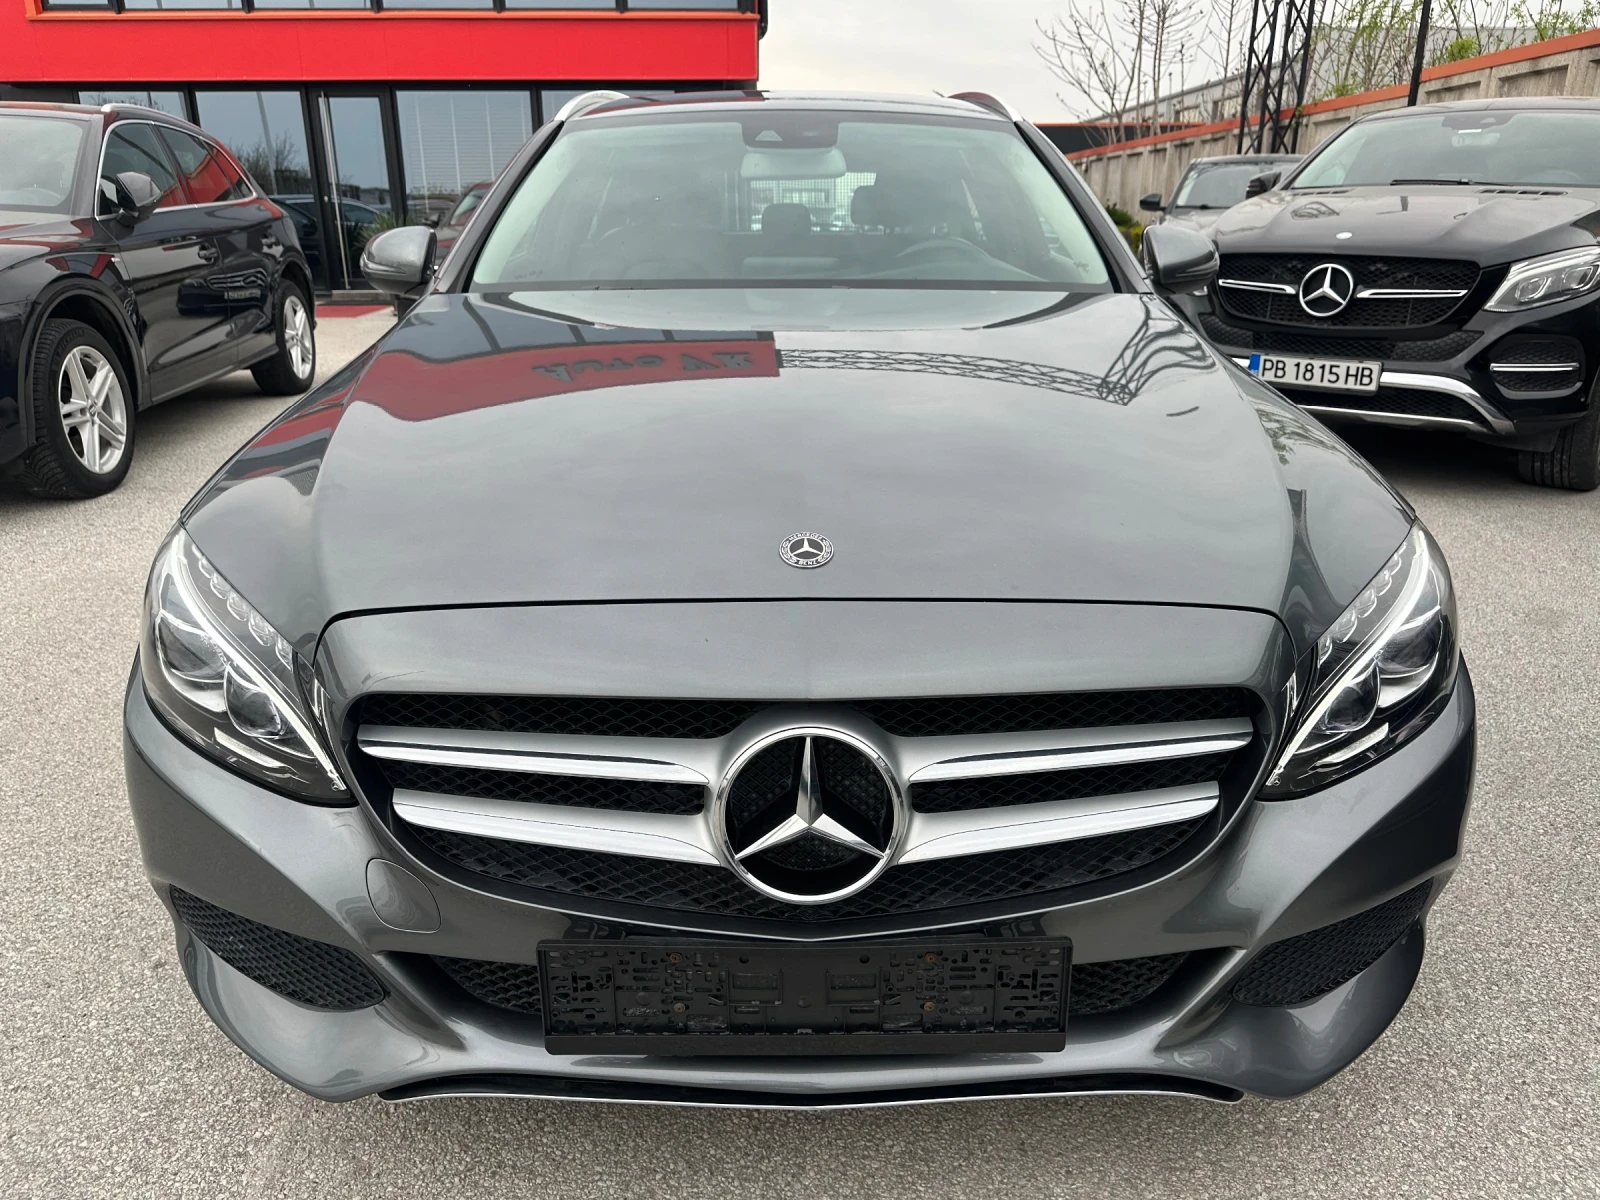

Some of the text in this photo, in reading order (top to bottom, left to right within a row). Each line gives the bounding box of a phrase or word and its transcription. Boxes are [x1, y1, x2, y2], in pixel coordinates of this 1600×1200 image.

[1261, 358, 1373, 387] PB 1815 HB
